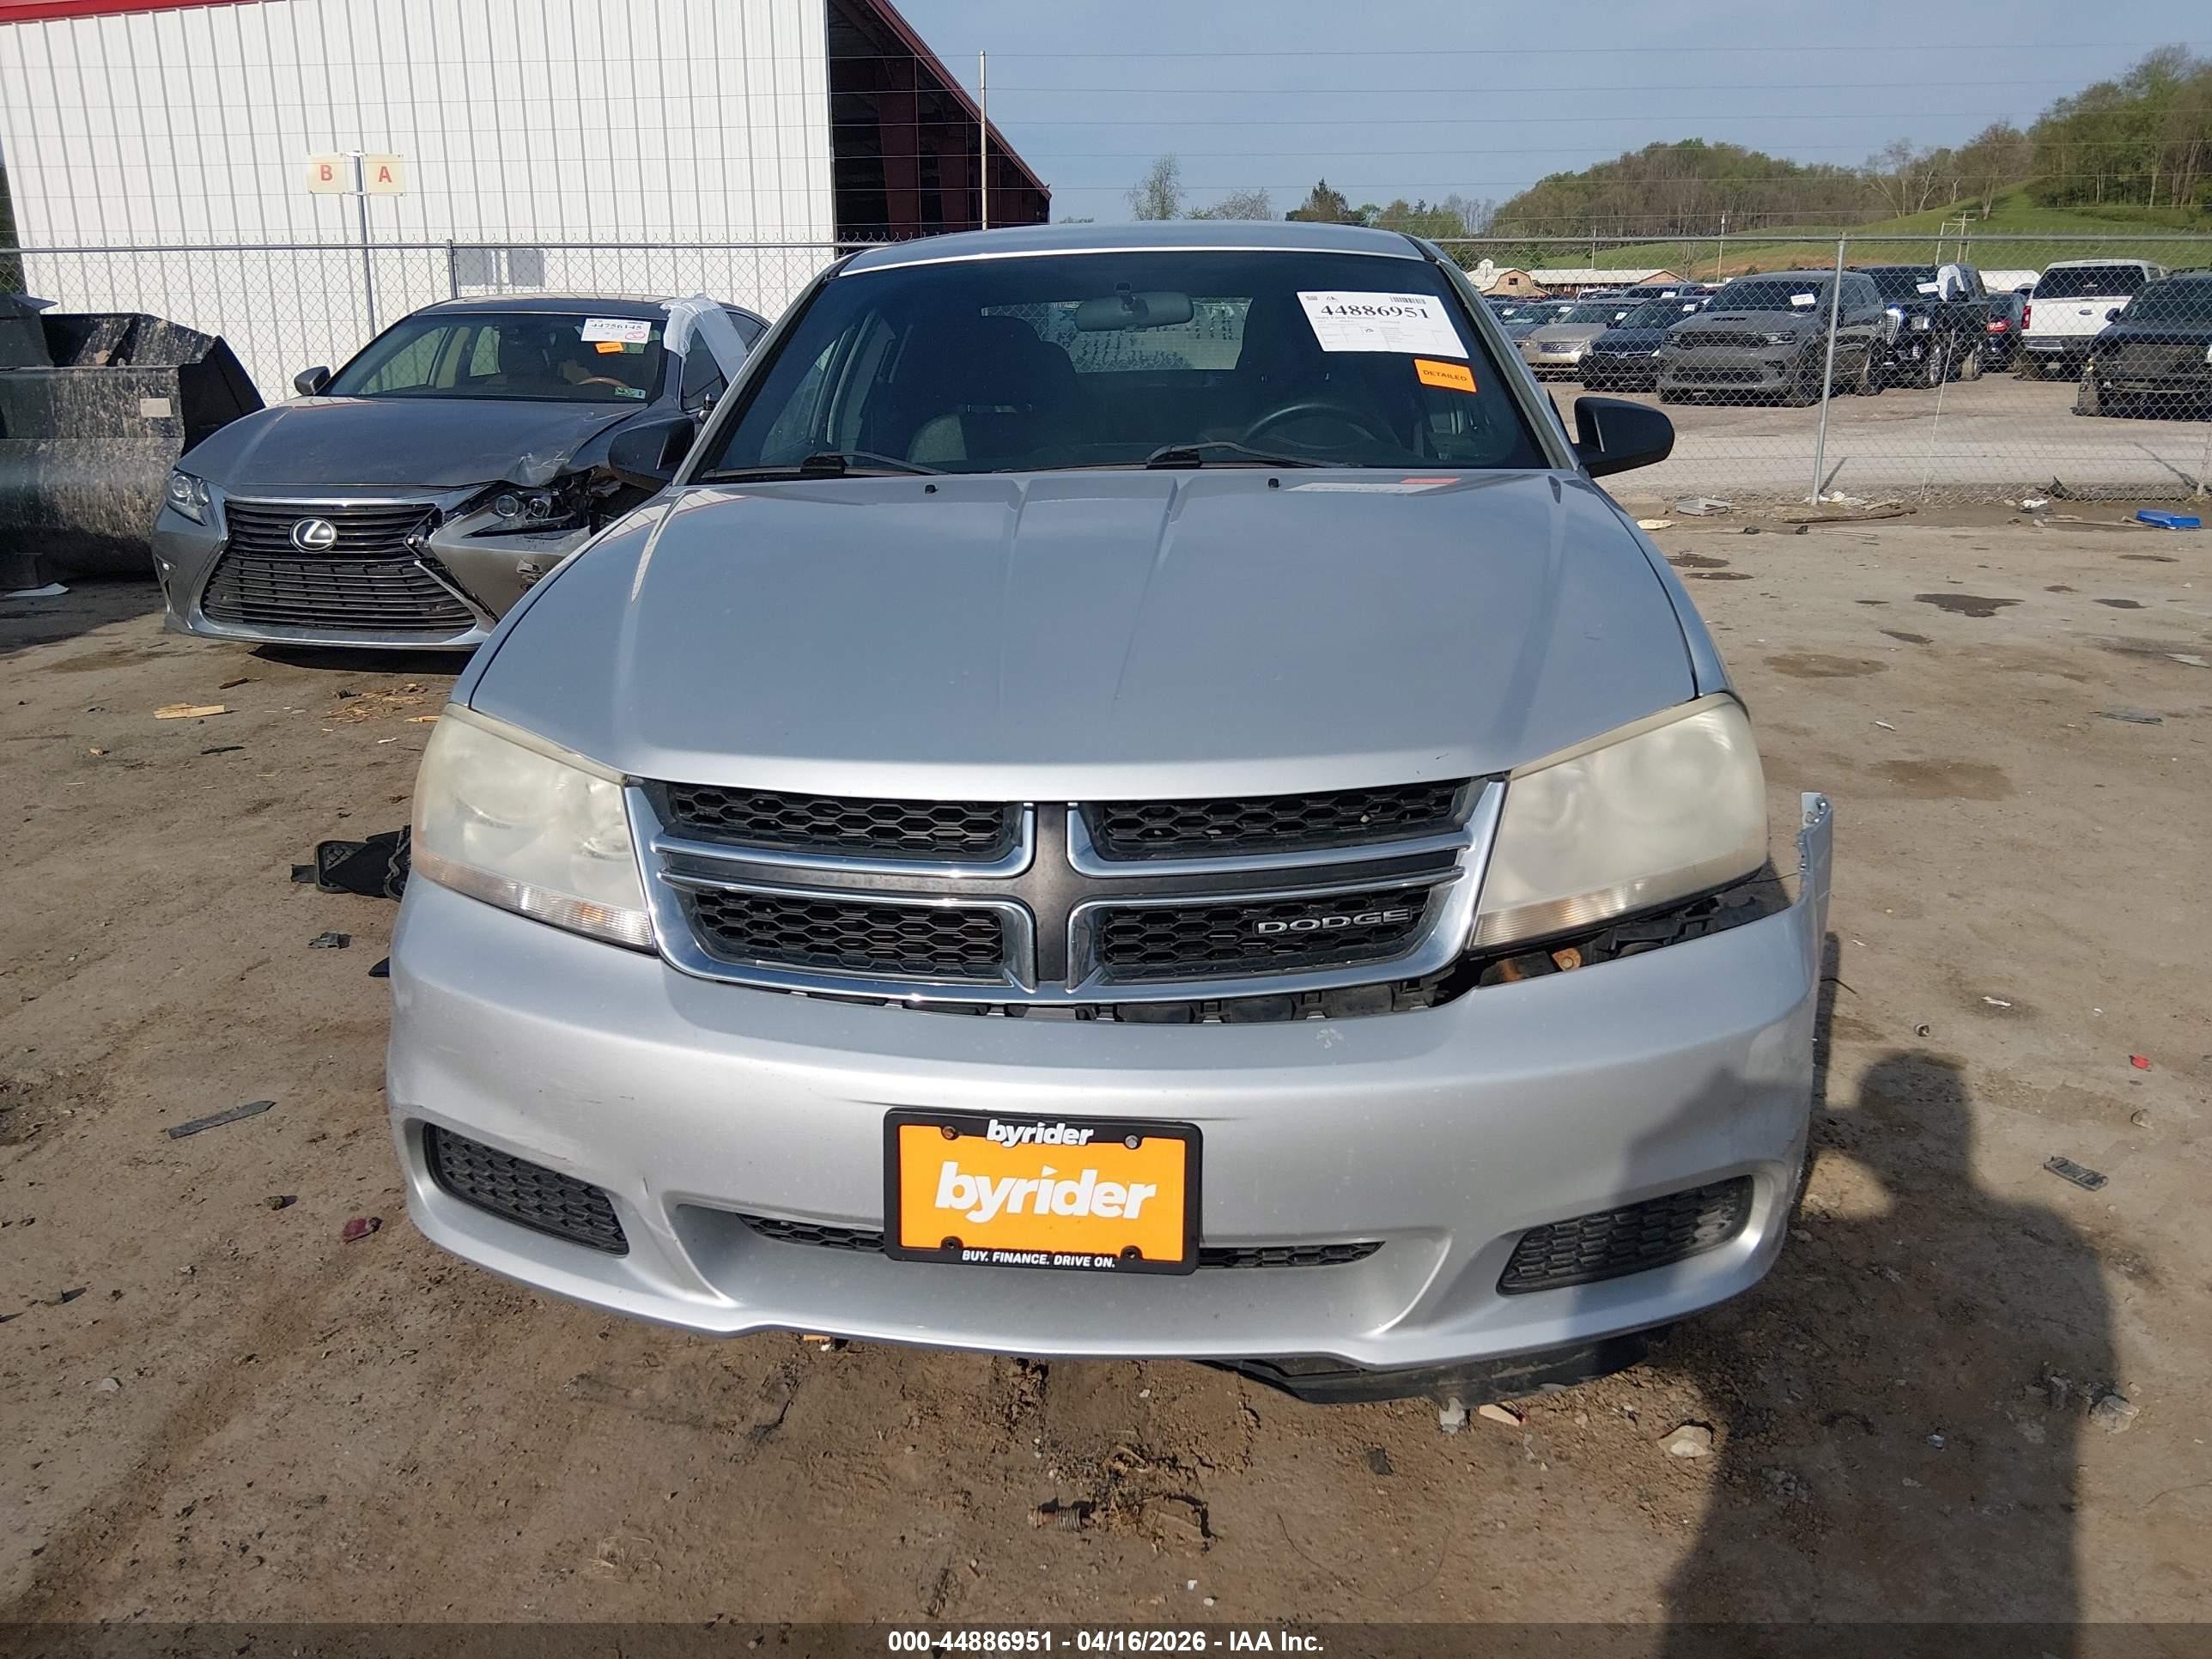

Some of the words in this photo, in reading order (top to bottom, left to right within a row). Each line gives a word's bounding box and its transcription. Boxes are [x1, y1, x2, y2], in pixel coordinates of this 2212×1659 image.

[319, 164, 333, 181] B
[378, 166, 392, 183] A
[1320, 304, 1429, 319] 44886951
[1422, 369, 1468, 381] DETAILED
[1258, 908, 1409, 934] DODGE
[986, 1119, 1094, 1148] byrider
[934, 1160, 1158, 1224] byrider
[962, 1249, 989, 1262] BUY.
[992, 1251, 1050, 1266] FINANCE.
[1053, 1255, 1092, 1267] DRIVE
[1093, 1256, 1115, 1268] ON.
